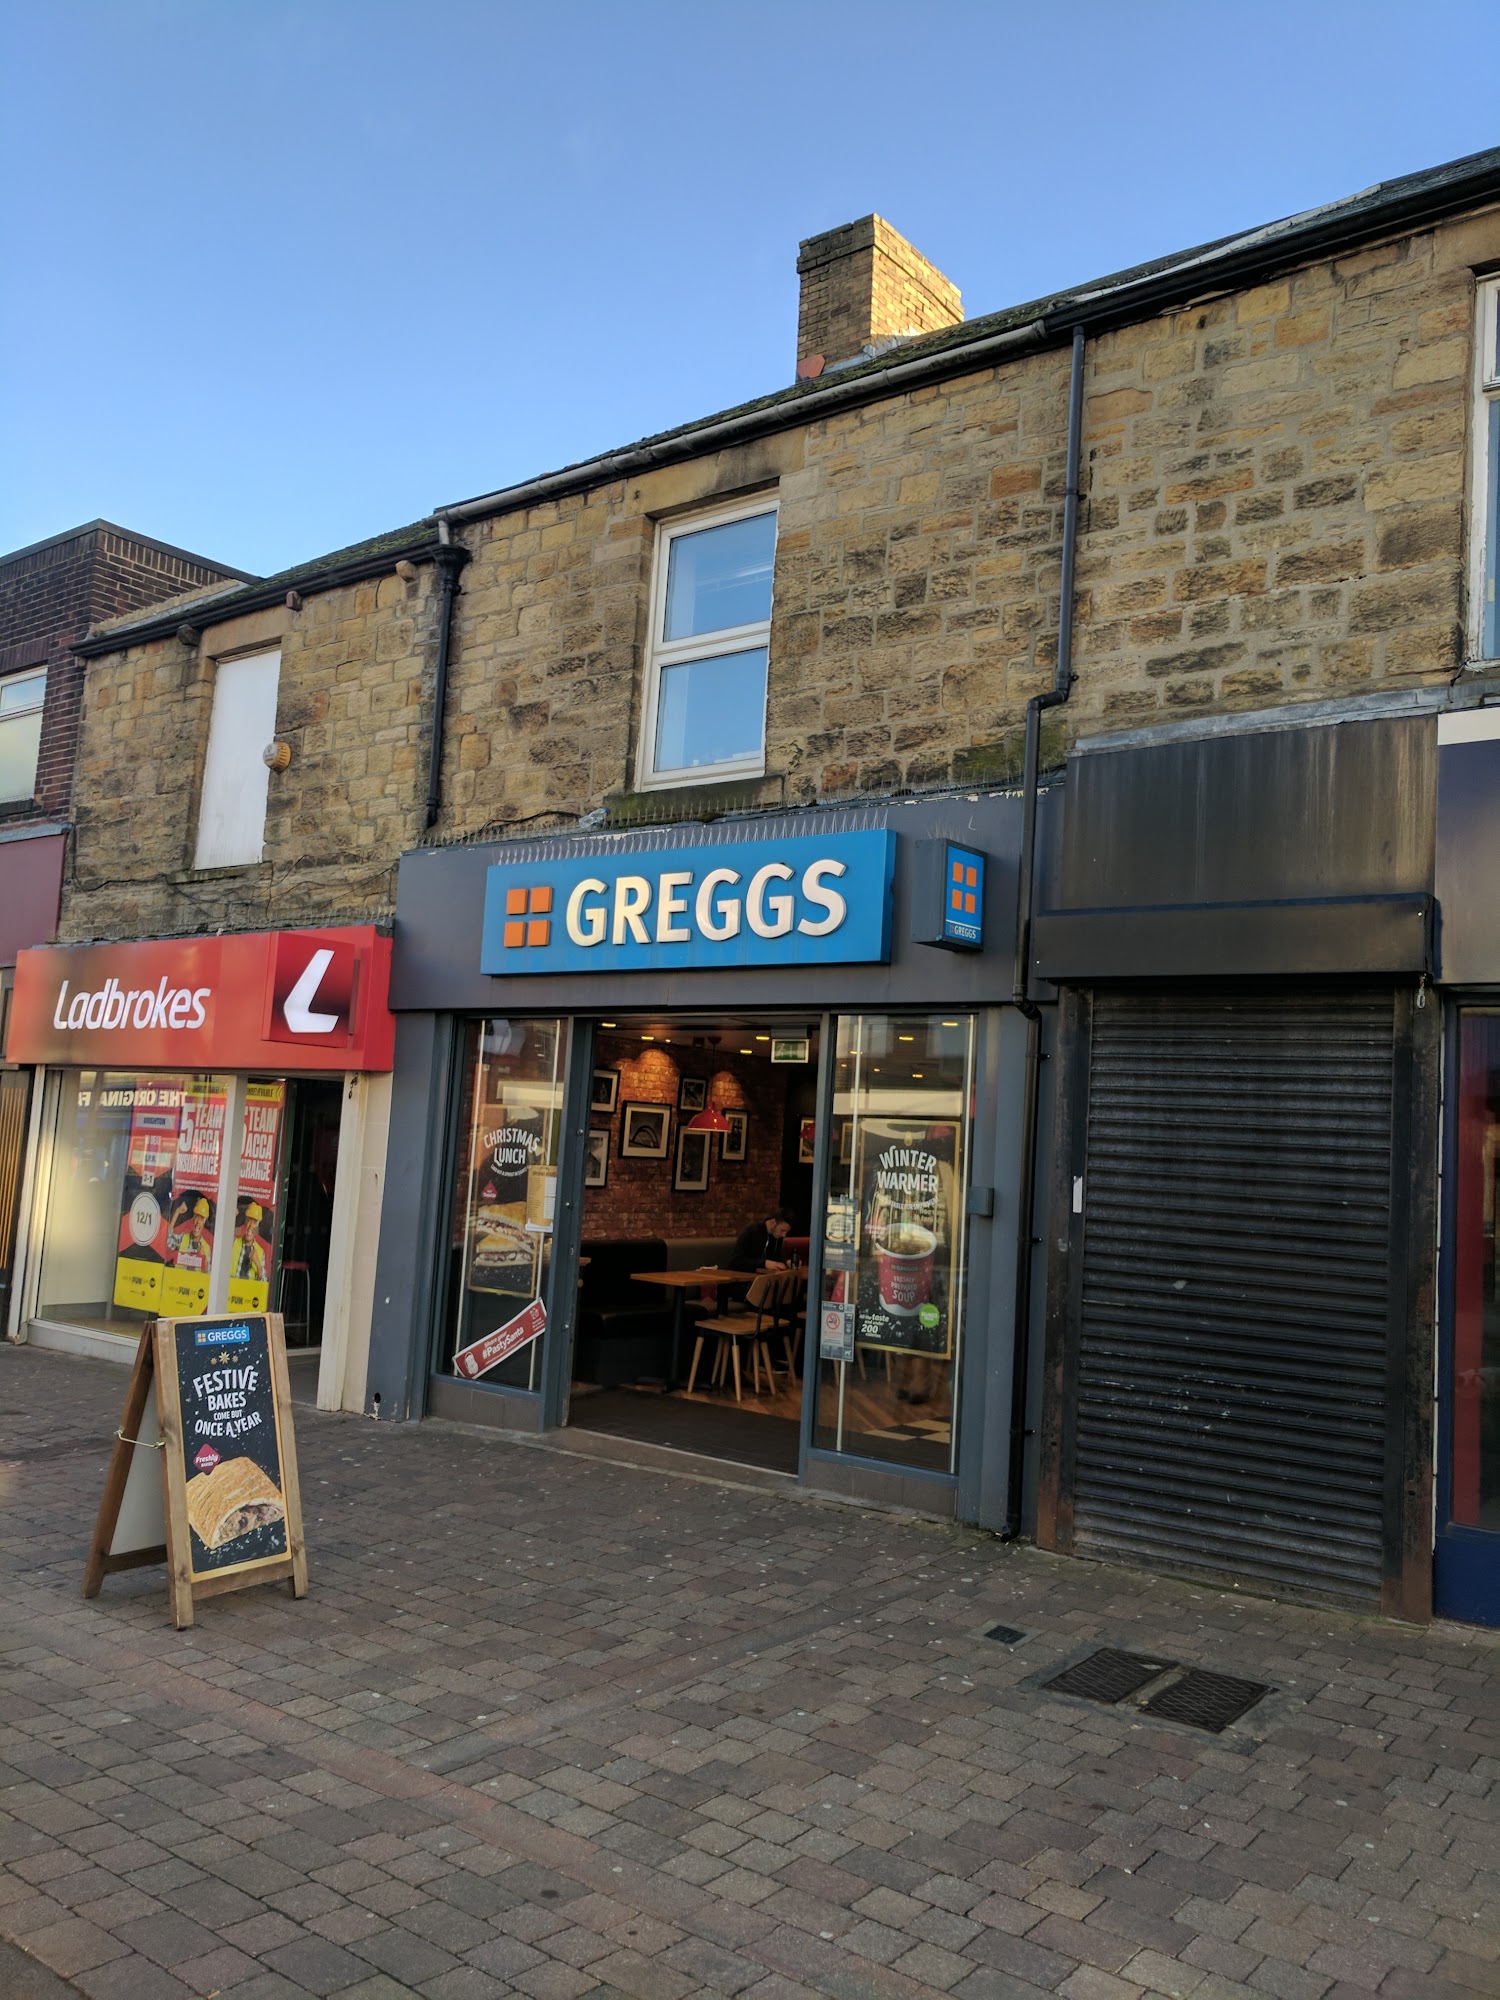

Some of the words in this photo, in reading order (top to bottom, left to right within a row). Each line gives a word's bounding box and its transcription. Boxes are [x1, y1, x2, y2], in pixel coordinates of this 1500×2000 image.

[566, 859, 846, 947] GREGGS
[954, 925, 977, 940] GREGGS
[53, 976, 211, 1030] Ladbrokes
[180, 1102, 195, 1152] 5
[195, 1102, 225, 1129] TEAM
[249, 1106, 278, 1134] TEAM
[191, 1128, 220, 1155] ACCA
[245, 1132, 273, 1160] ACCA
[483, 1127, 541, 1154] CHRISTMAS
[494, 1147, 526, 1167] LUNCH
[879, 1145, 937, 1174] WINTER
[877, 1171, 938, 1195] WARMER
[137, 1211, 152, 1226] 12/1
[892, 1290, 915, 1302] SOUP
[861, 1324, 879, 1334] 200
[872, 1313, 890, 1322] taste
[207, 1329, 247, 1342] GREGGS
[482, 1326, 524, 1360] #PastySanta
[192, 1365, 259, 1398] FESTIVE
[207, 1391, 247, 1411] BAKES
[194, 1419, 223, 1437] ONCE
[225, 1421, 237, 1438] A
[233, 1411, 263, 1433] YEAR
[213, 1411, 231, 1421] COME
[230, 1409, 243, 1419] BUT
[195, 1453, 219, 1463] Freshly
